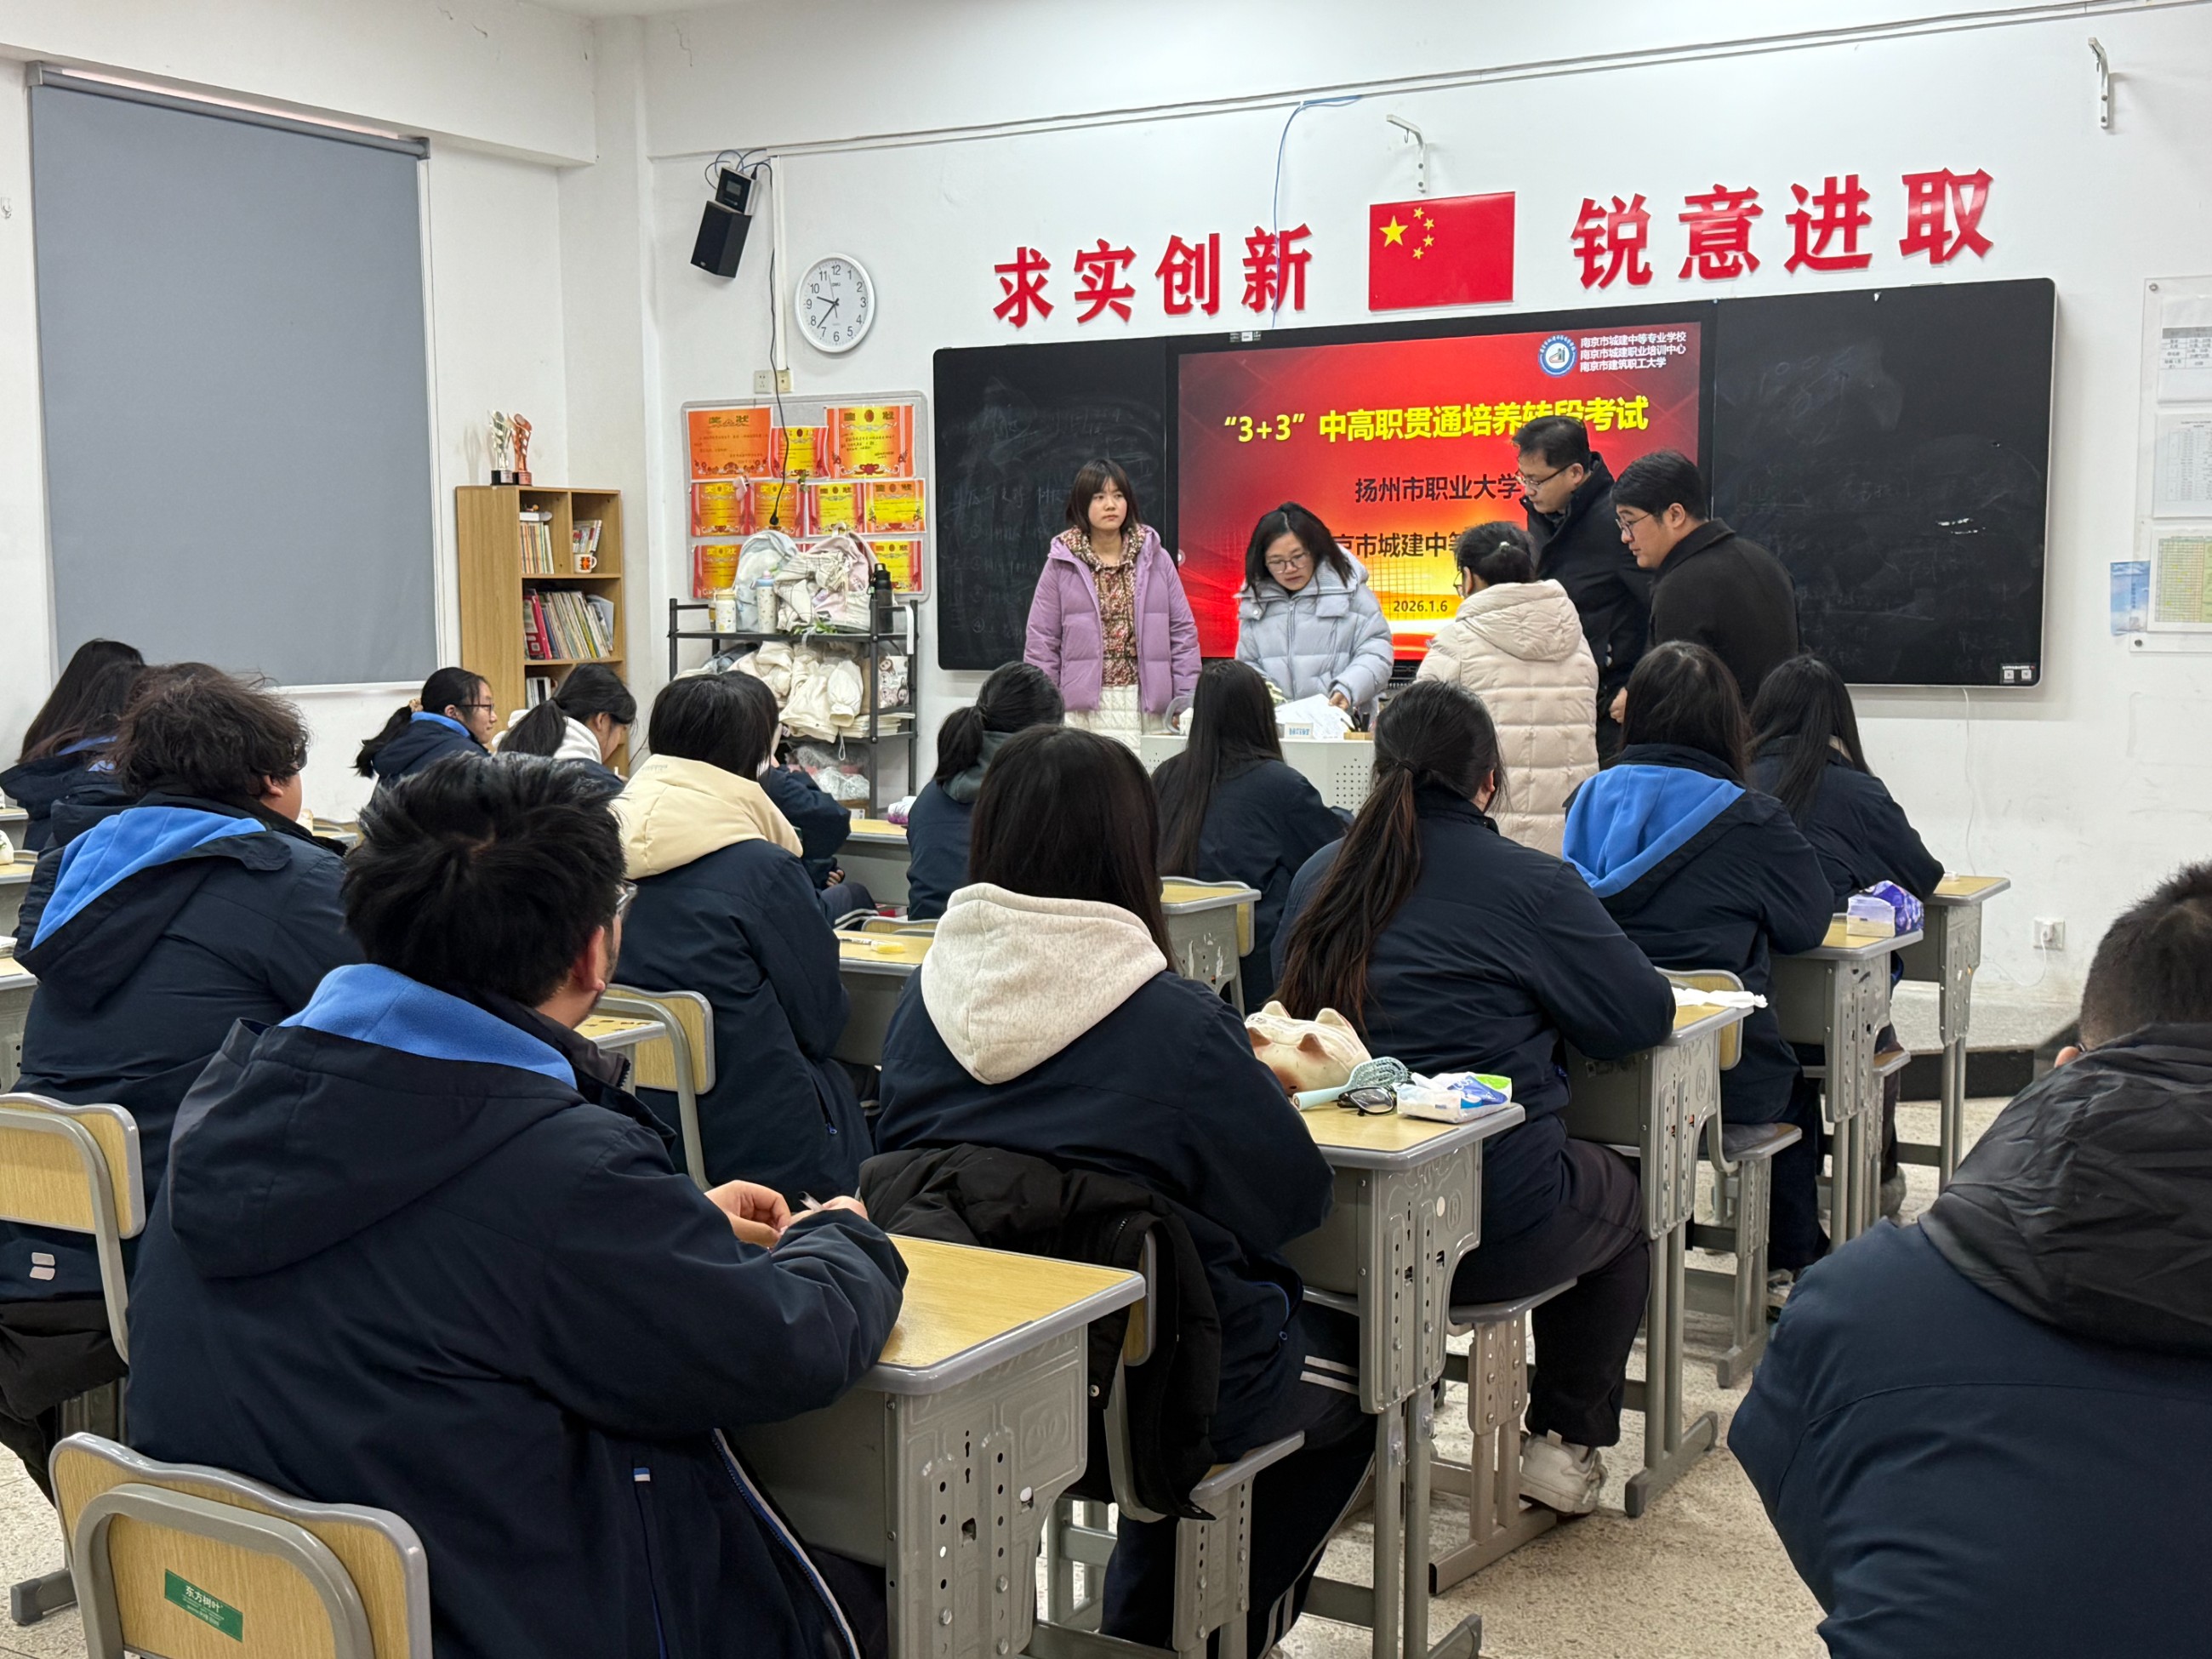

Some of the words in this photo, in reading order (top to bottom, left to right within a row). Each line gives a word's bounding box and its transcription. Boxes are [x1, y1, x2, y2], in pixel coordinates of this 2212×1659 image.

[1571, 168, 1993, 290] 锐意进取
[831, 265, 841, 275] 12
[847, 270, 852, 279] 1
[819, 271, 827, 281] 11
[993, 223, 1313, 328] 求实创新
[810, 283, 819, 294] 10
[857, 282, 863, 292] 2
[807, 299, 812, 309] 9
[860, 297, 866, 307] 3
[810, 316, 816, 326] 8
[856, 315, 862, 324] 4
[821, 327, 826, 337] 7
[834, 332, 840, 341] 6
[847, 327, 852, 336] 5
[1581, 331, 1686, 348] 南京市城建中等专业学校
[1581, 344, 1686, 360] 南京市城建职业培训中心
[1580, 357, 1667, 373] 南京市建筑职工大学
[1356, 473, 1521, 503] 扬州市职业大学
[1394, 600, 1448, 612] 2026.1.6
[185, 1585, 221, 1613] 东方树叶
